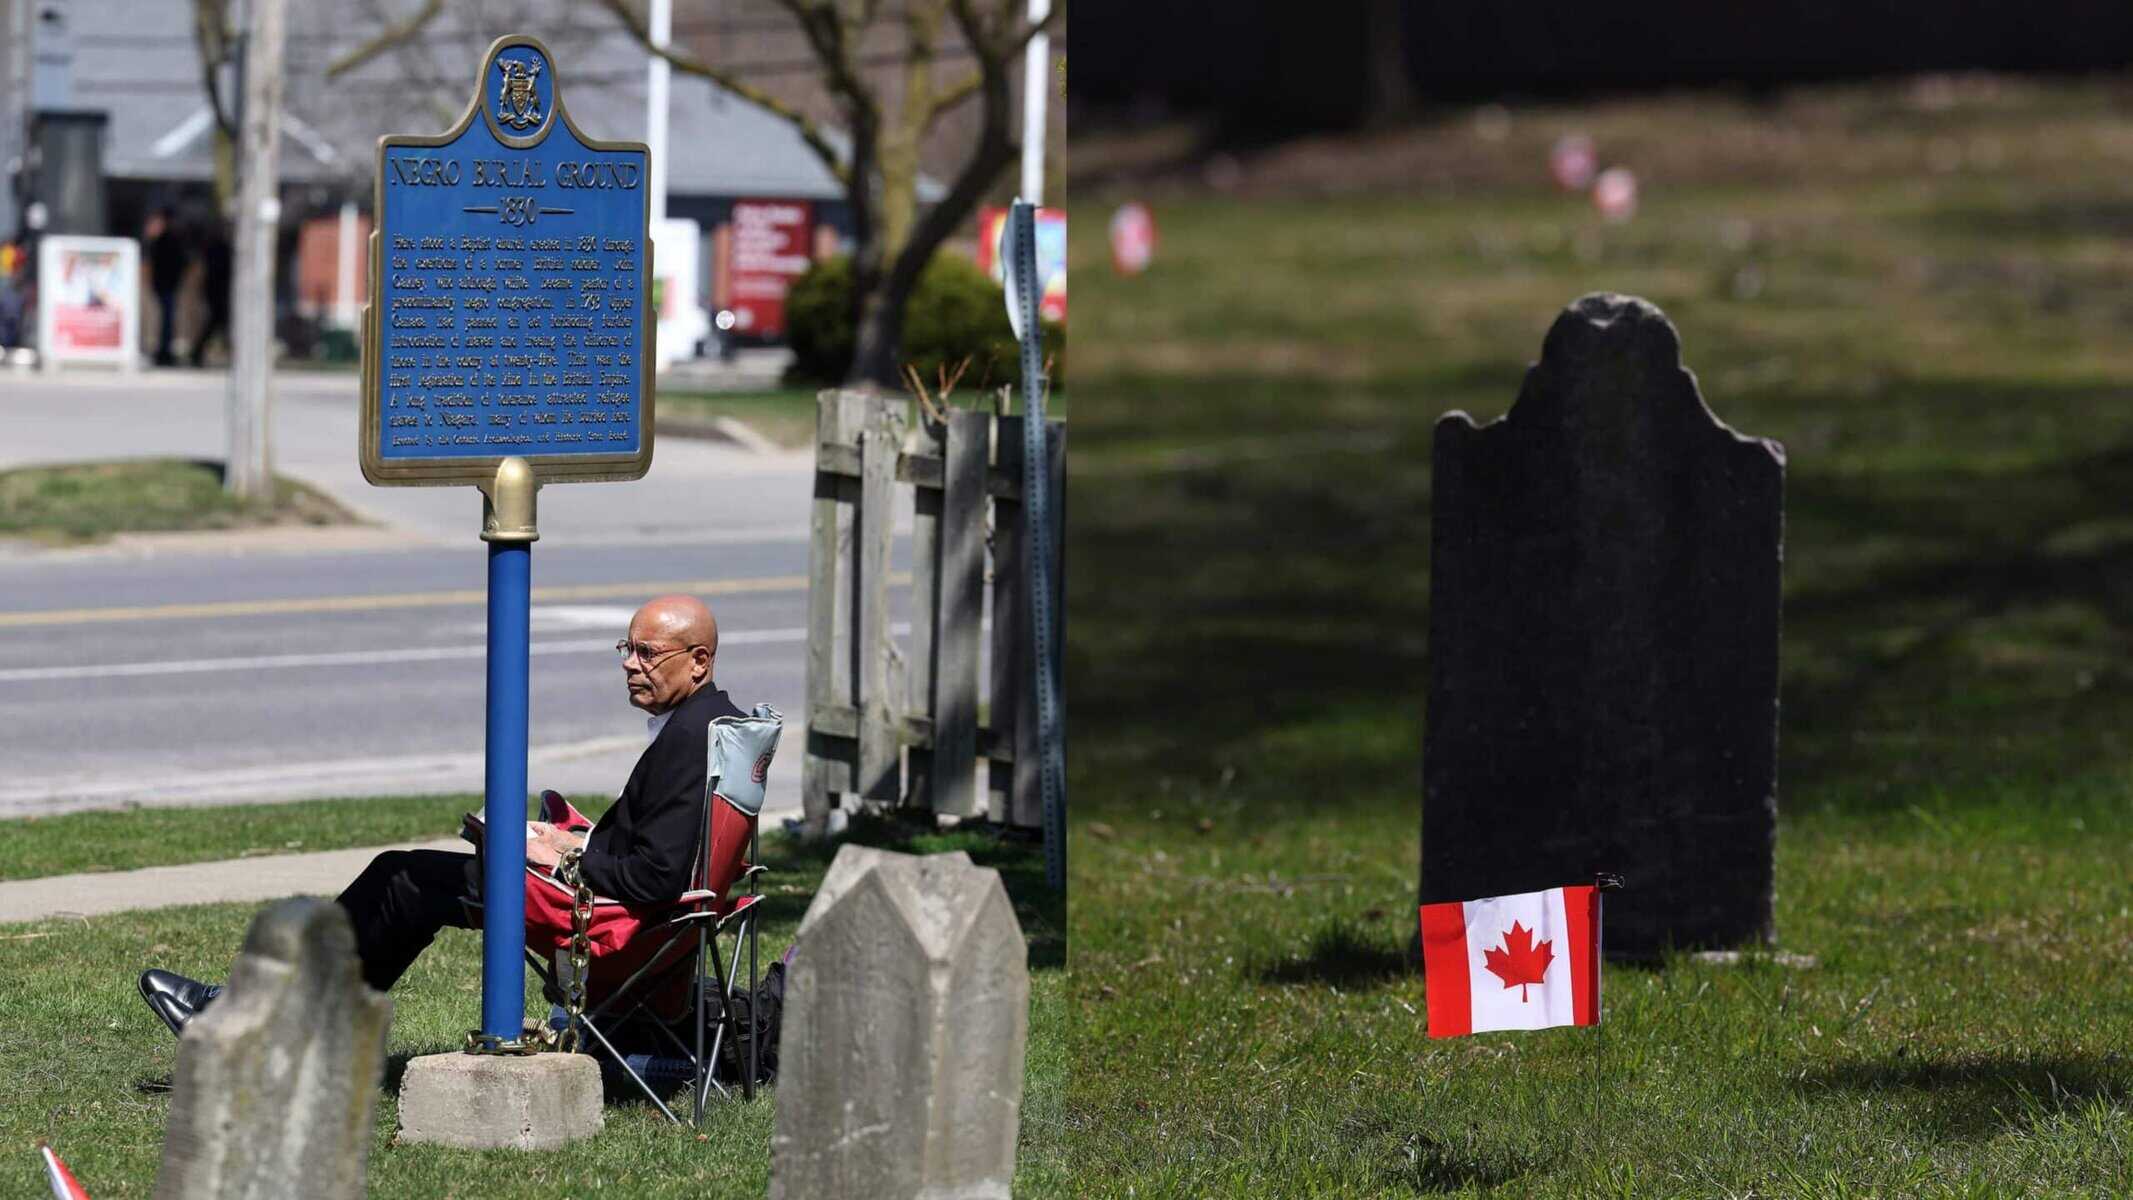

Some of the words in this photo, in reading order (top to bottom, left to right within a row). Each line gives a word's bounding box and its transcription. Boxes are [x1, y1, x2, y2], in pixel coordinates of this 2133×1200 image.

[390, 157, 461, 187] NEGRO
[472, 159, 546, 188] BURIAL
[556, 160, 641, 190] GROUND
[499, 196, 536, 227] 1830
